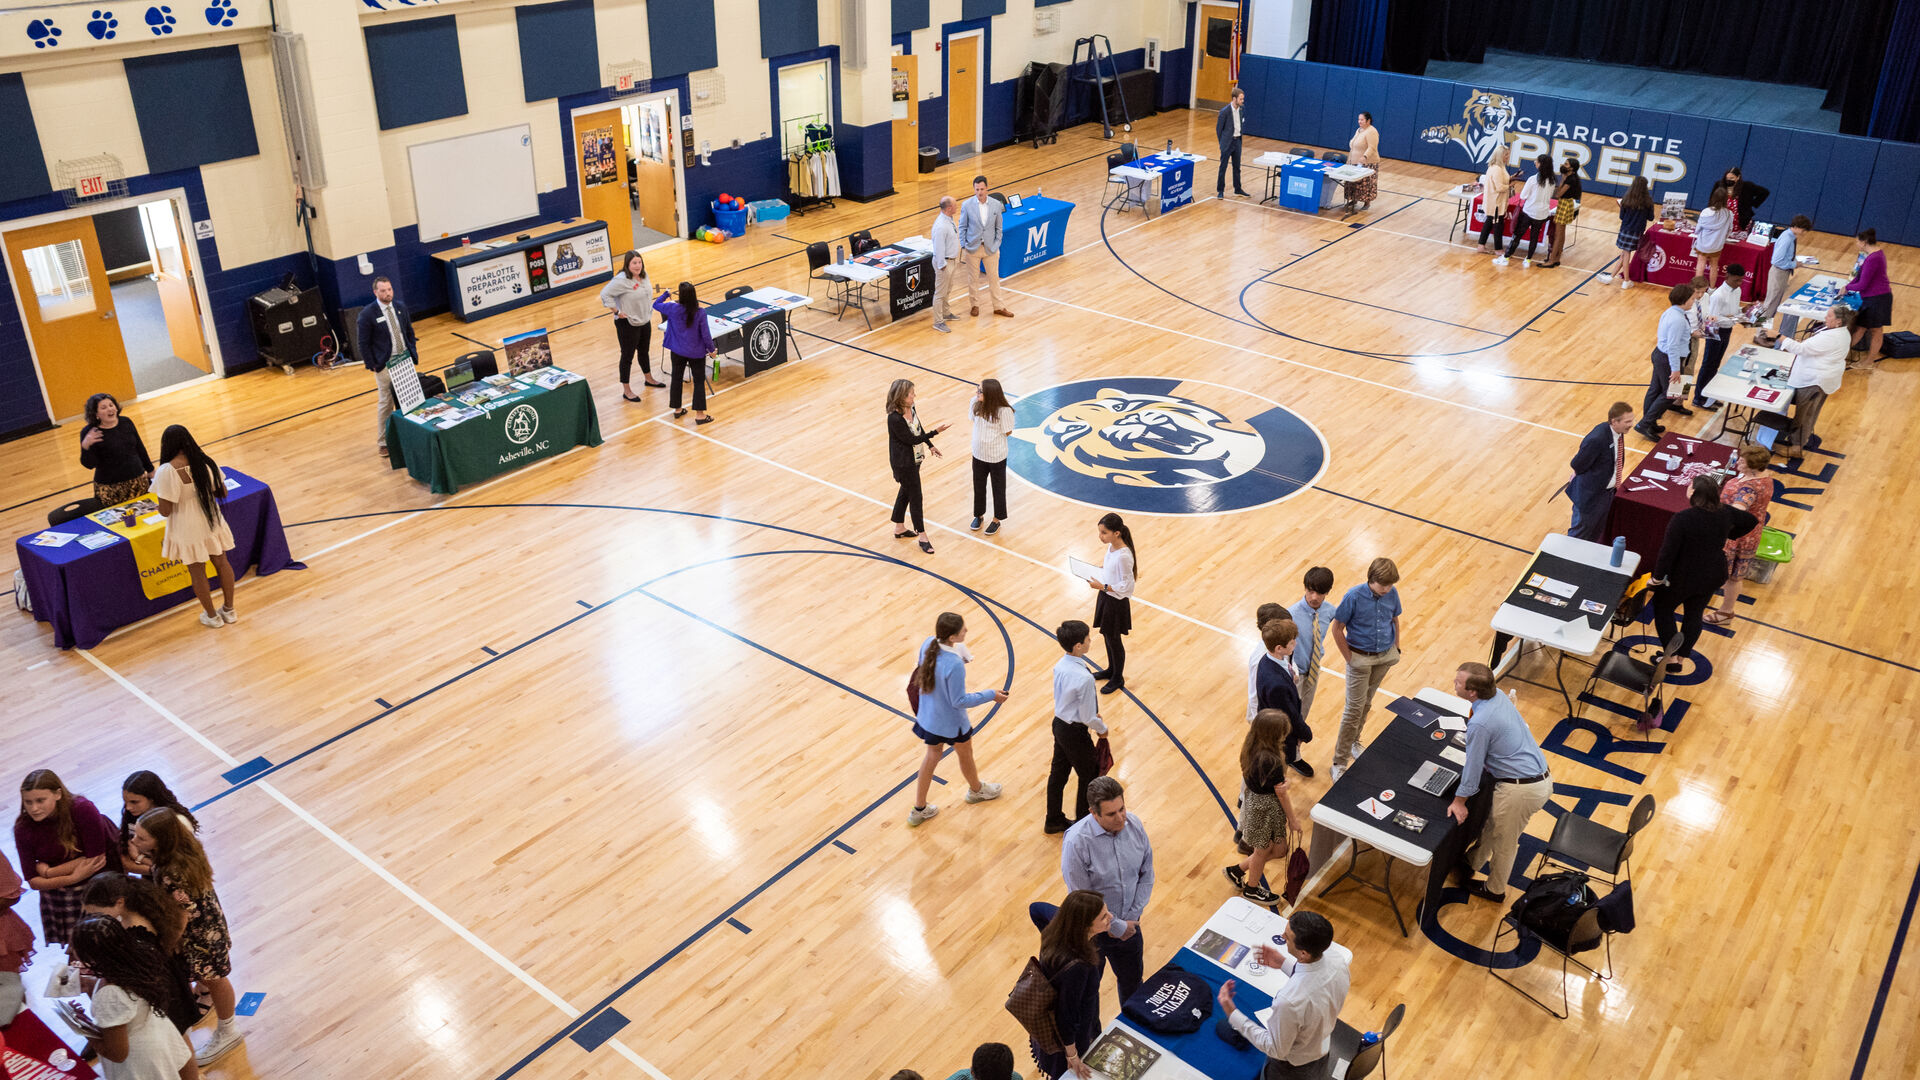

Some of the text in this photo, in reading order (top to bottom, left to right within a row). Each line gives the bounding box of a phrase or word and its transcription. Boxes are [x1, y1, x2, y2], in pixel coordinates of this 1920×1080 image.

[619, 74, 632, 89] EXIT
[1516, 117, 1683, 155] CHARLOTTE
[1505, 131, 1687, 190] PREP
[80, 176, 103, 195] EXIT
[585, 236, 604, 246] HOME
[1025, 220, 1051, 256] M
[529, 259, 545, 269] POSS
[557, 261, 578, 273] PREP
[467, 272, 521, 293] PREPARATORY
[471, 265, 515, 284] CHARLOTTE
[485, 284, 507, 295] SCHOOL
[896, 289, 930, 307] Kimball Union
[902, 298, 924, 311] Academy
[507, 407, 536, 429] CHRIST SCHOOL
[498, 440, 550, 465] Asheville, NC
[140, 559, 184, 578] CHATHA
[1145, 982, 1176, 1008] SCHOOL
[1151, 980, 1192, 1018] ASHEVILLE
